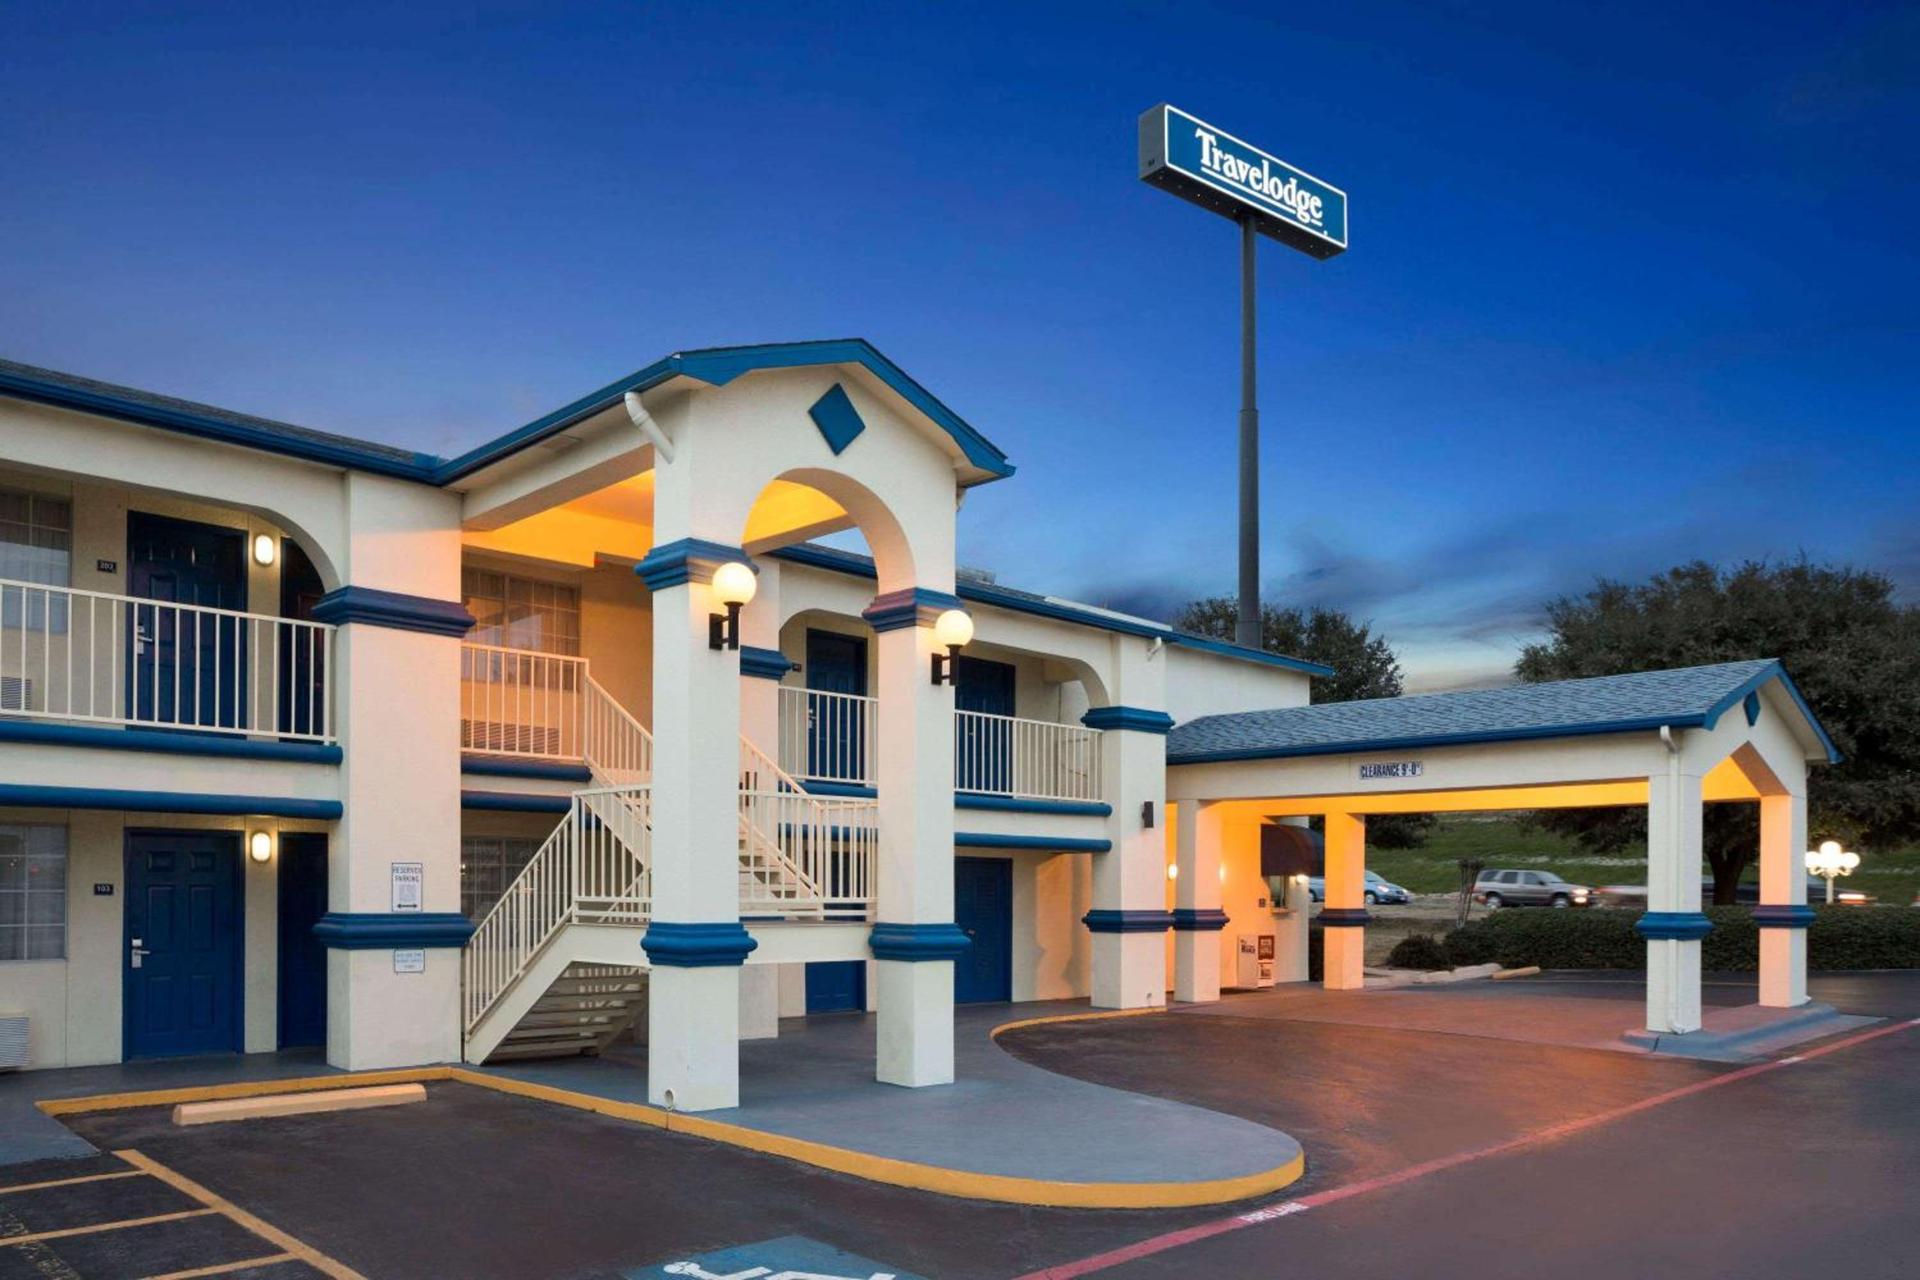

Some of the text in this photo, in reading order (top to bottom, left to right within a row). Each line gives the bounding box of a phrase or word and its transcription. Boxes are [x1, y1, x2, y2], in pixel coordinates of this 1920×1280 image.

[1195, 127, 1323, 224] Travelodge
[1361, 763, 1399, 778] CLEARANCE
[395, 874, 420, 882] PARKING
